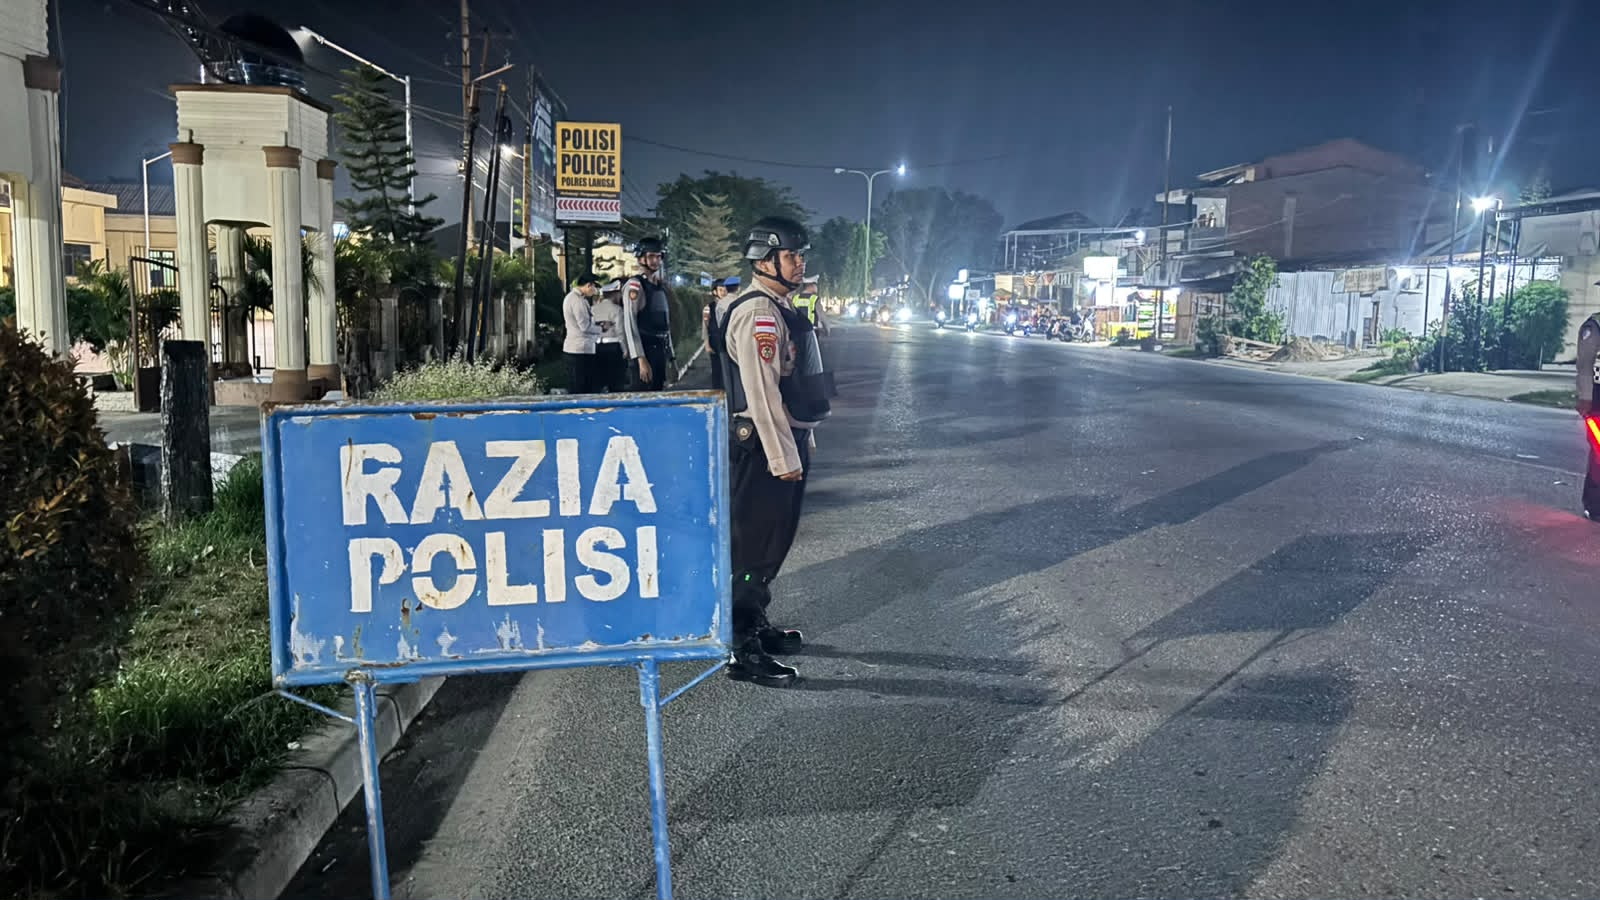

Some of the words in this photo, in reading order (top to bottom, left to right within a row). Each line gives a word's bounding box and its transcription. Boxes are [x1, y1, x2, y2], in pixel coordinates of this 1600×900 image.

[561, 128, 616, 151] POLISI
[561, 153, 616, 176] POLICE
[561, 177, 588, 187] POLRES
[588, 177, 616, 188] LANGSA
[340, 435, 657, 526] RAZIA
[347, 525, 659, 613] POLISI
